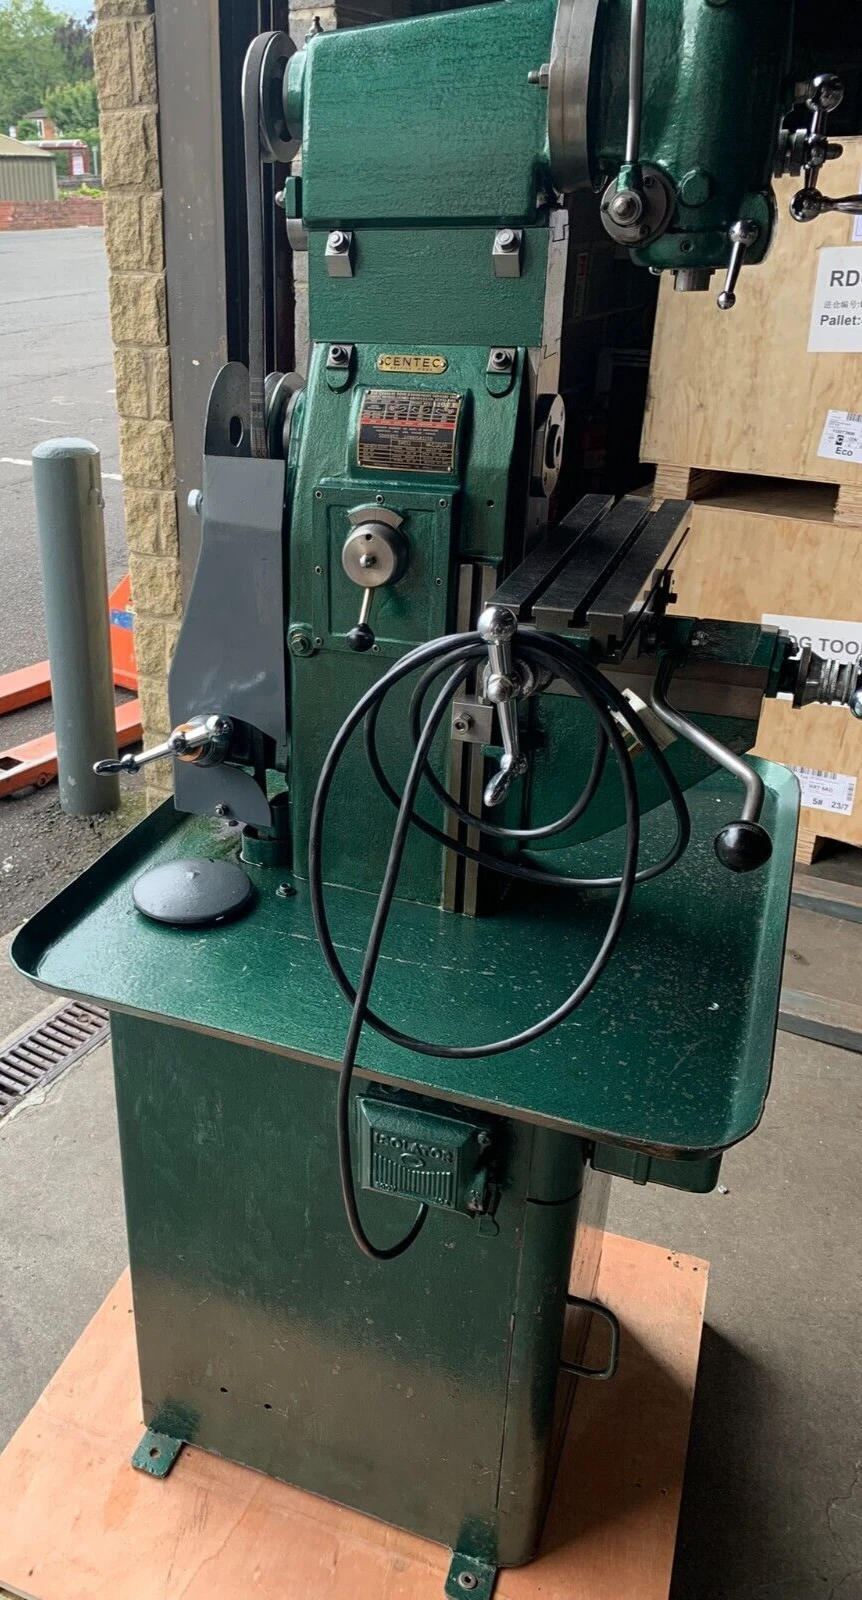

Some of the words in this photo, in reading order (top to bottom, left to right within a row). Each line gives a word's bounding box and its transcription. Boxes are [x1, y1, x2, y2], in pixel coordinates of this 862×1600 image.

[830, 270, 862, 287] RD
[820, 314, 862, 326] Pallet:
[384, 356, 440, 368] CENTEC
[835, 447, 853, 456] Eco
[818, 638, 862, 655] TOO
[830, 801, 849, 811] 23/7
[373, 1132, 454, 1163] ISOLATOR
